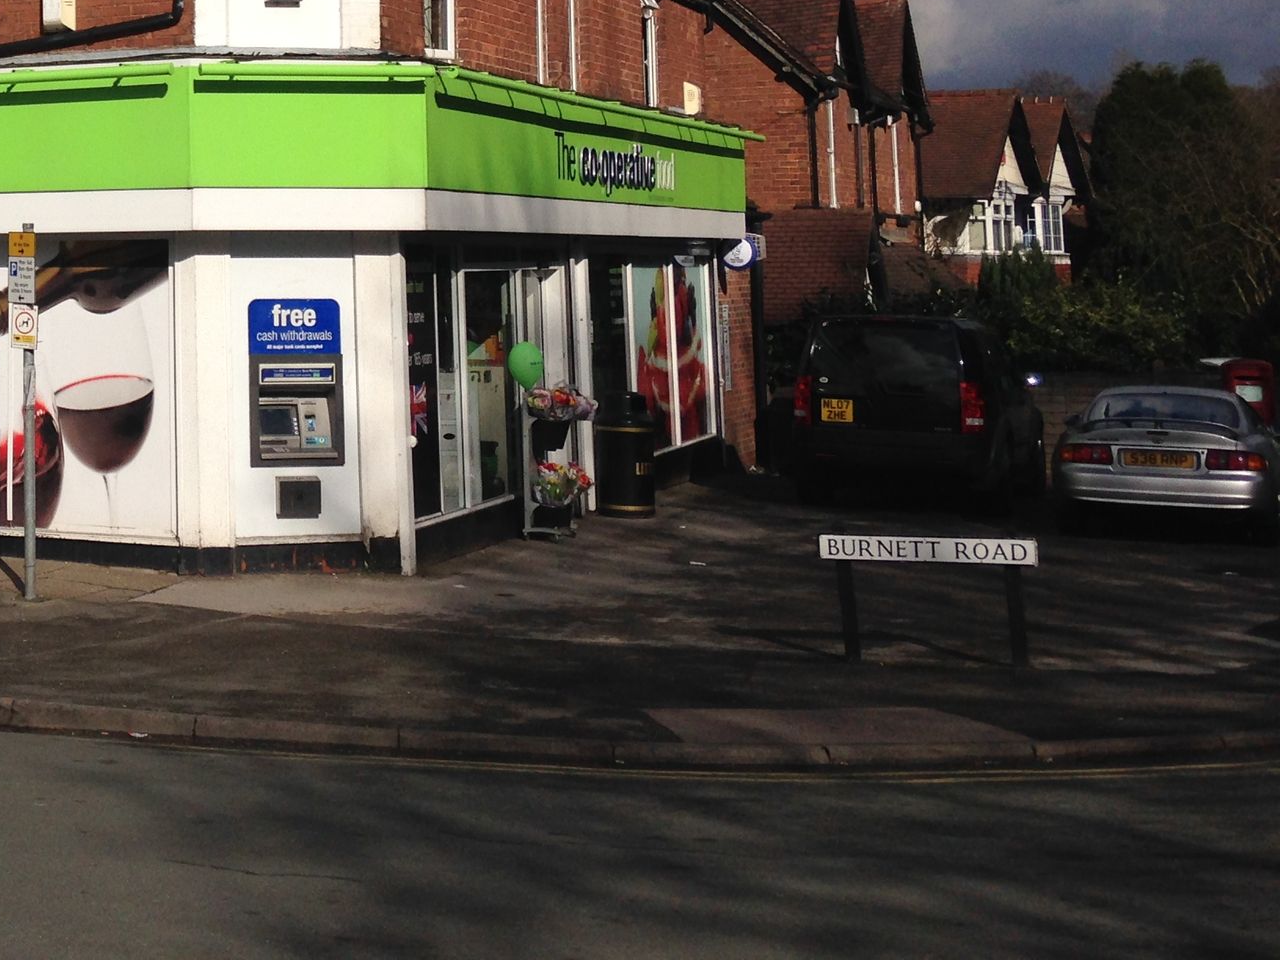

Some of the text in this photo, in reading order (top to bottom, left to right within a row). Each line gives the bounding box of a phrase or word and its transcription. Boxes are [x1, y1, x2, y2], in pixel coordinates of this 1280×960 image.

[554, 131, 675, 197] The co-operative food
[271, 303, 317, 327] free
[256, 330, 333, 341] cash withdrawals
[823, 399, 850, 410] NL07
[826, 410, 847, 421] ZHE
[1160, 453, 1188, 466] RNP
[827, 538, 1028, 562] BURNETT ROAD
